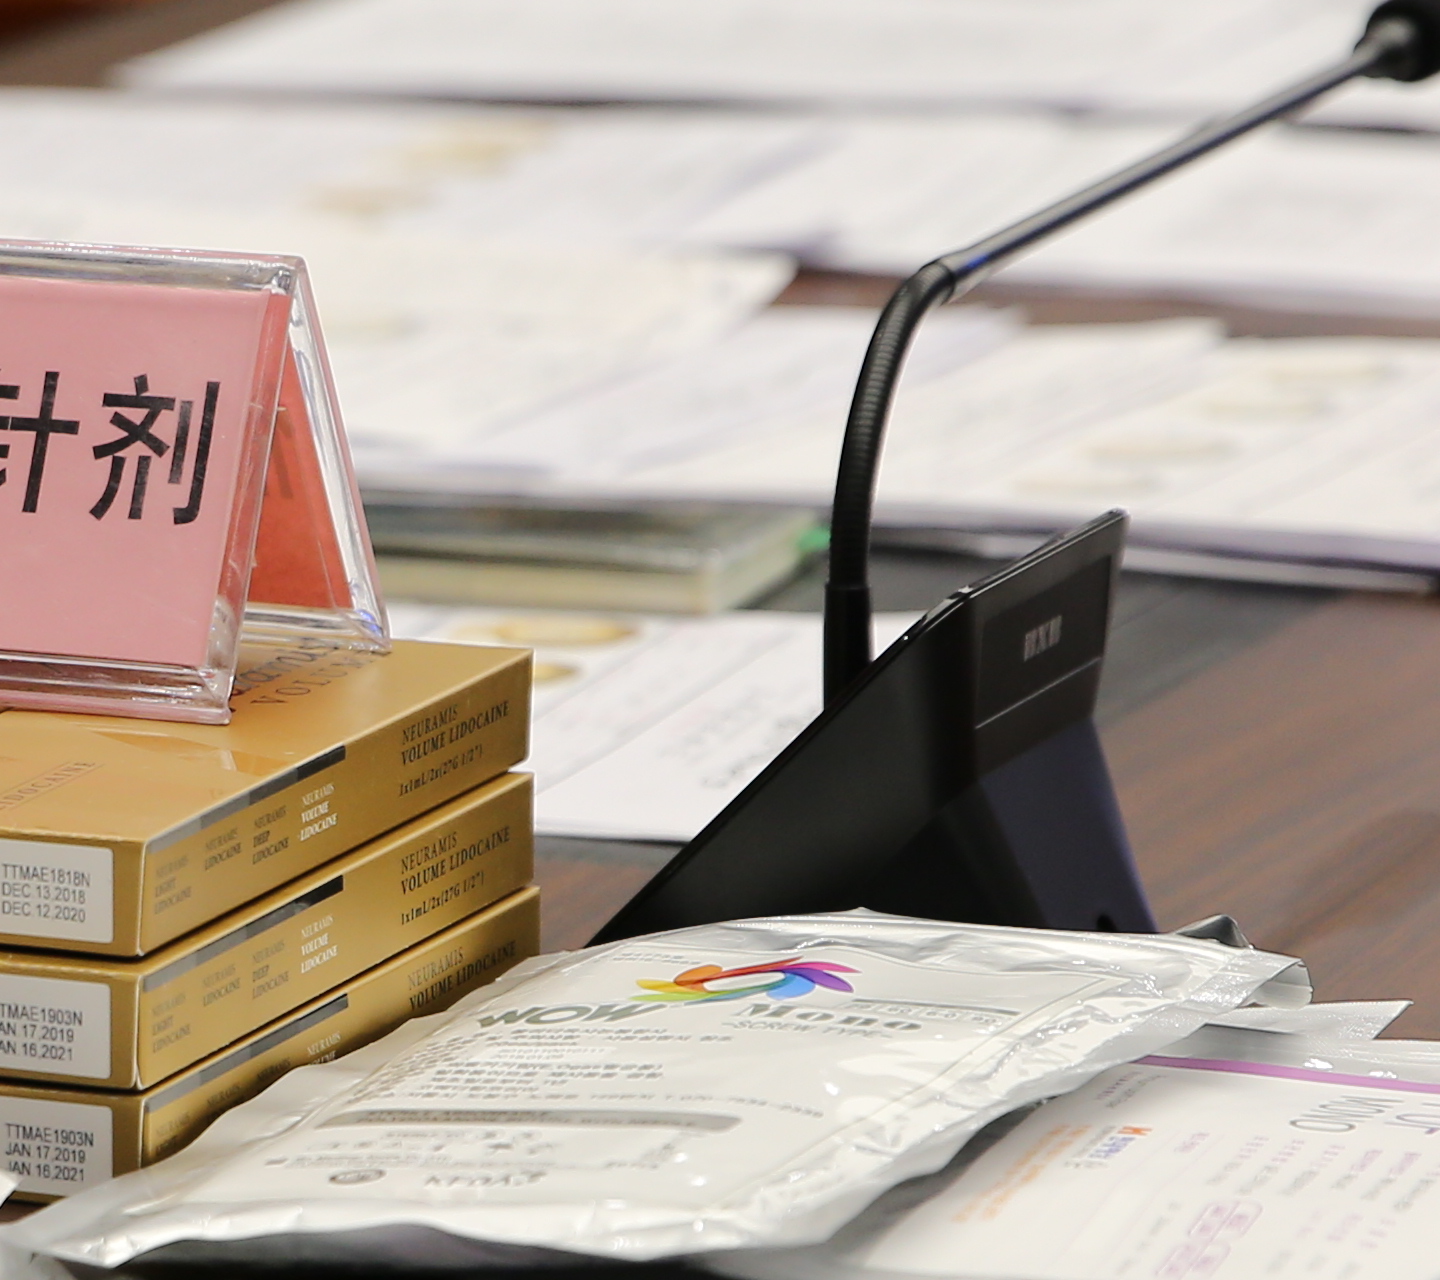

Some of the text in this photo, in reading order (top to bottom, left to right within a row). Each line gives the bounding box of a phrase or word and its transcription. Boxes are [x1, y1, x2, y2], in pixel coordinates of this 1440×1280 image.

[401, 700, 509, 766] VOLUME LIDOCAINE
[402, 704, 458, 745] NEURAMIS
[301, 800, 329, 824] VOLUME
[299, 813, 338, 841] LIDOCAINE
[401, 831, 458, 874] NEURAMIS
[401, 826, 511, 895] VOLUME LIDOCAINE
[2, 863, 90, 888] TTMAE1818N
[301, 932, 329, 956] VOLUME
[301, 945, 338, 973] LIDOCAINE
[408, 946, 465, 990] NEURAMIS
[409, 940, 517, 1012] VOLUME LIDOCAINE
[479, 1003, 669, 1028] WOW
[4, 1122, 94, 1148] TTMAE1903N
